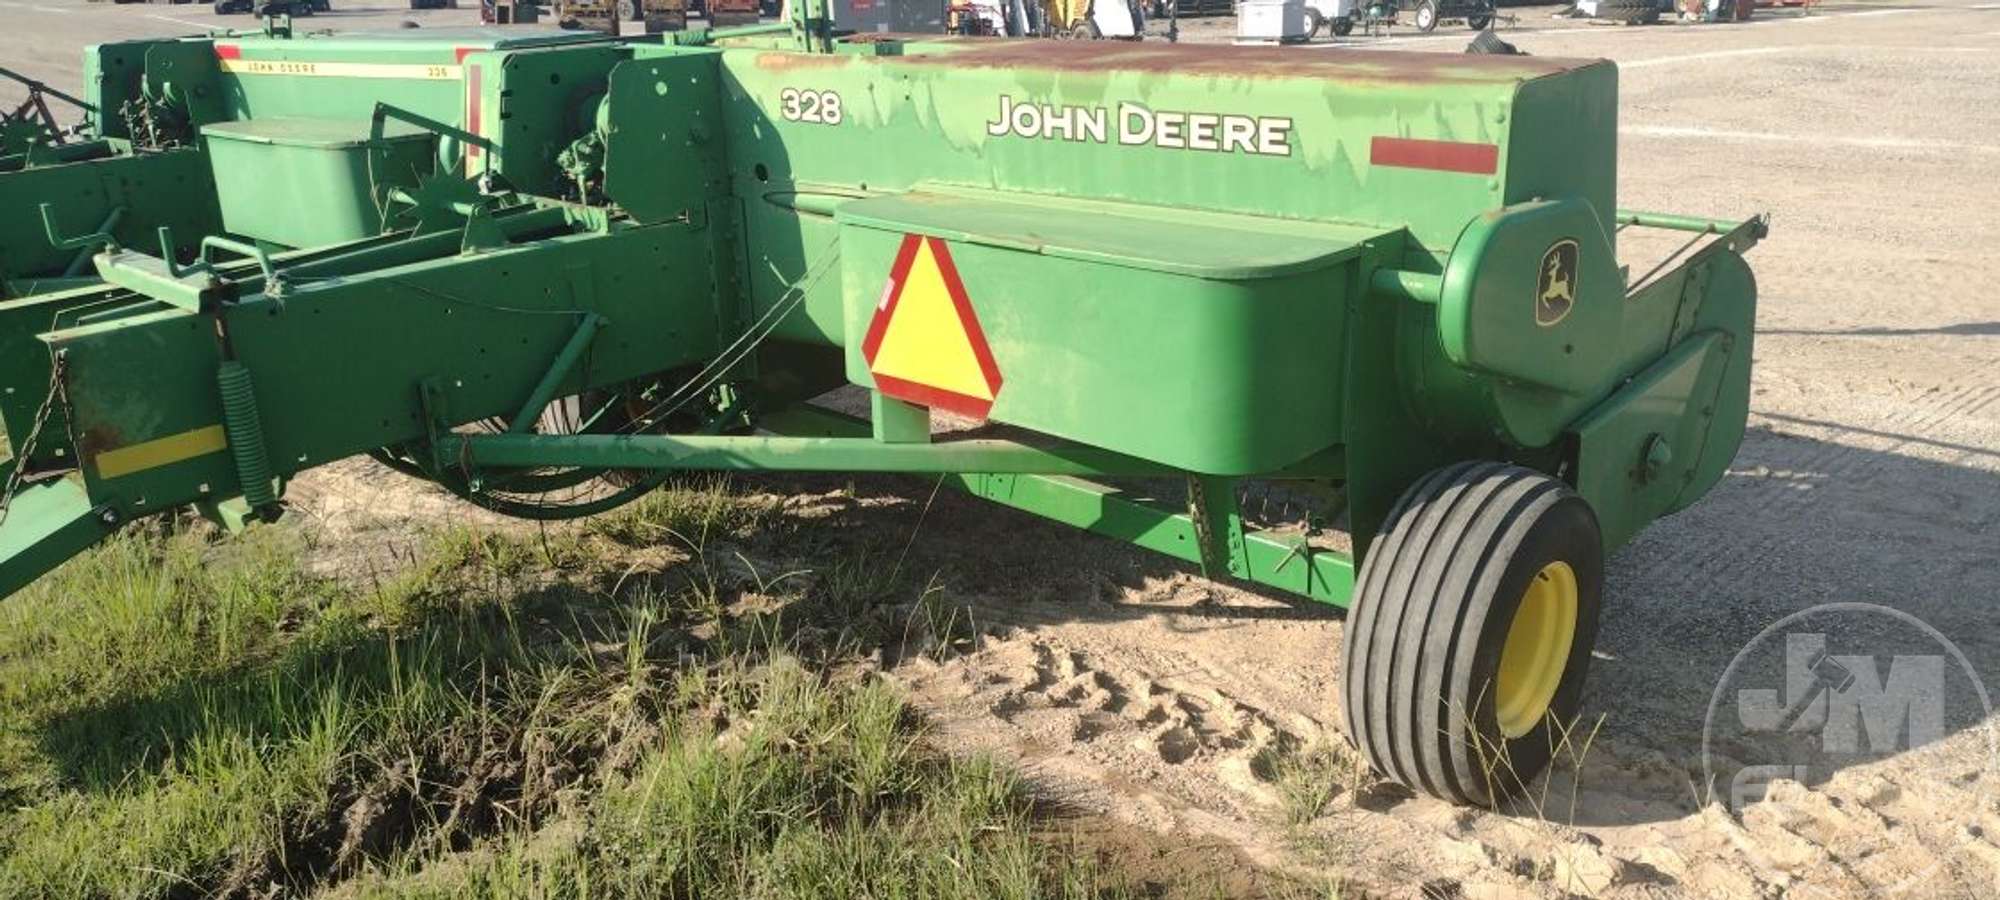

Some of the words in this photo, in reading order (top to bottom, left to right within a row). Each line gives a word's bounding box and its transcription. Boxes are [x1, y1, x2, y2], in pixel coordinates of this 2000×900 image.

[780, 87, 842, 126] 328
[987, 95, 1107, 143] JOHN
[1117, 101, 1293, 156] DEERE
